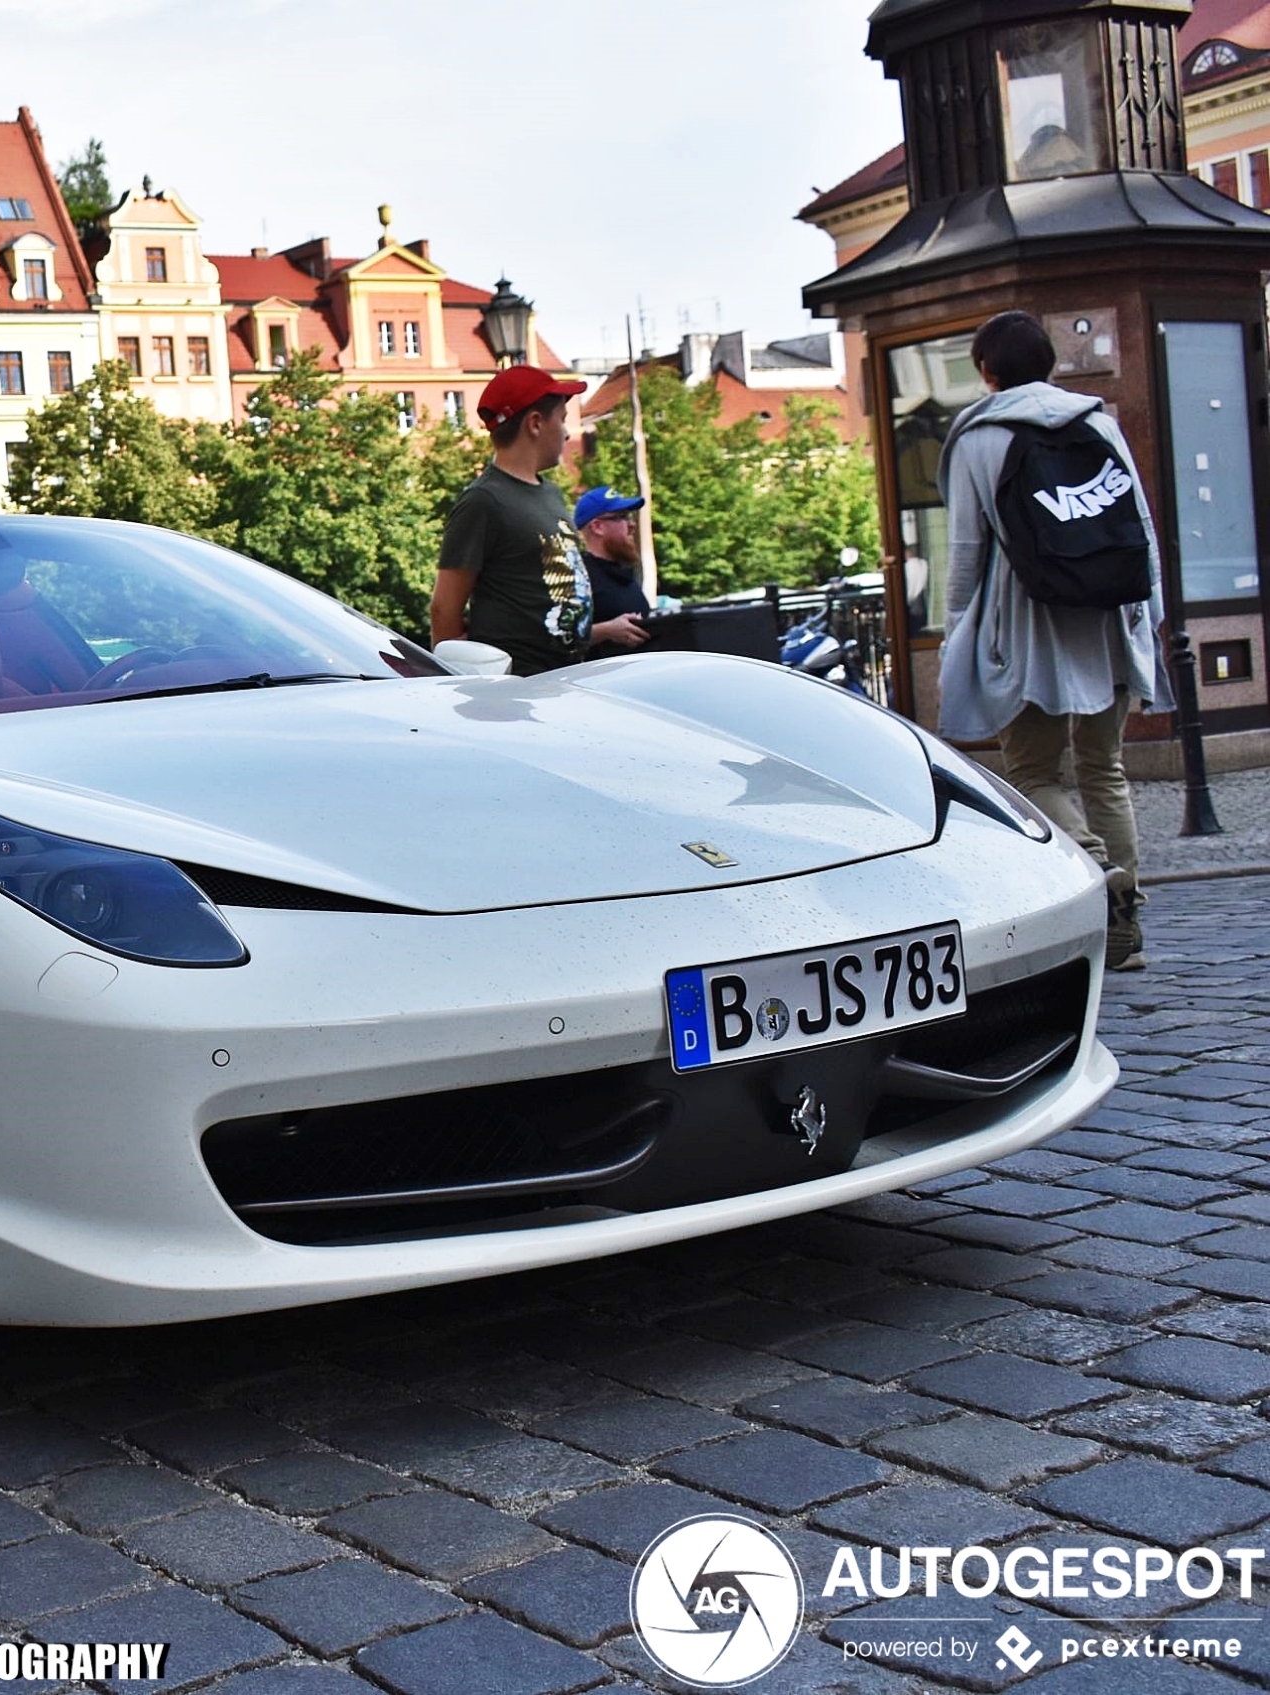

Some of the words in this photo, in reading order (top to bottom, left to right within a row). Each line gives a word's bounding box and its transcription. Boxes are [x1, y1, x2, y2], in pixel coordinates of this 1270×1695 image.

[1032, 457, 1133, 522] VANS
[684, 1029, 698, 1051] D
[710, 974, 753, 1051] B
